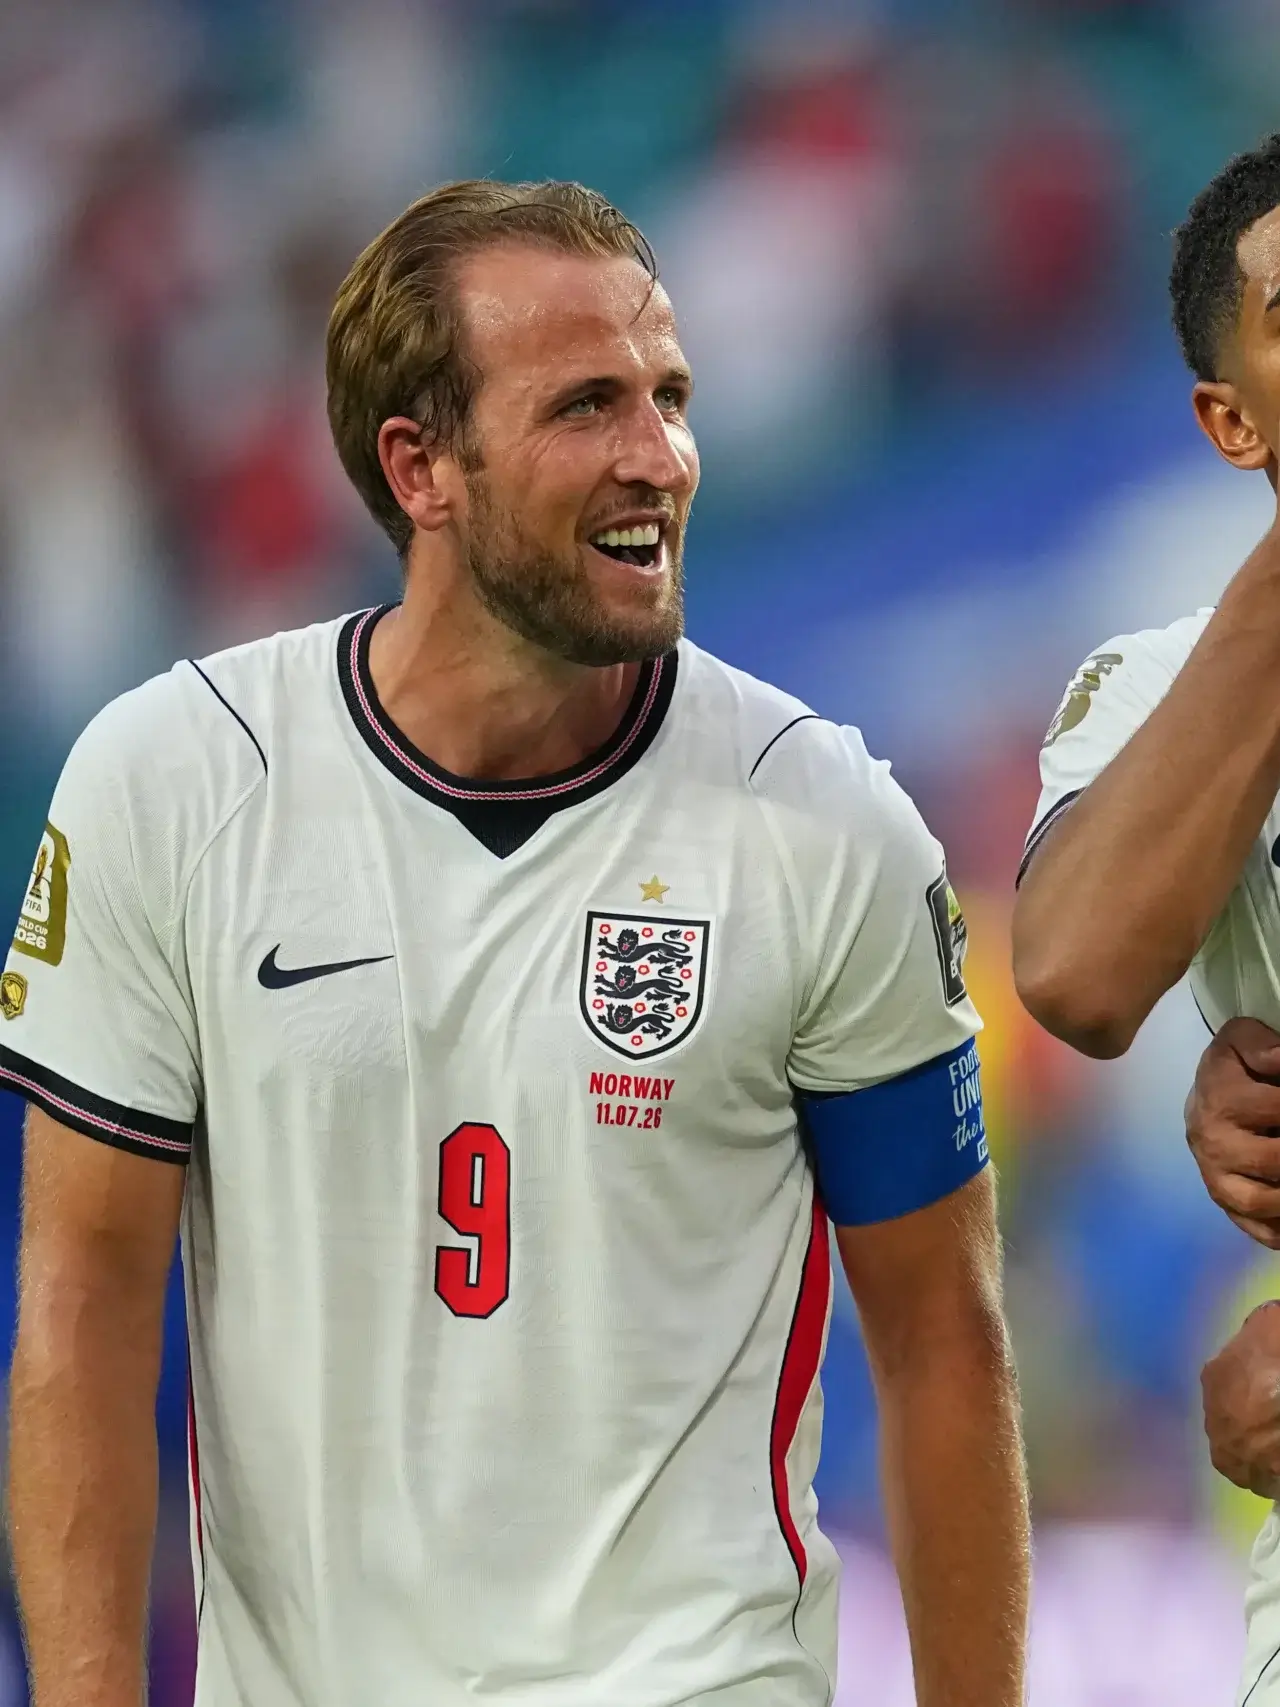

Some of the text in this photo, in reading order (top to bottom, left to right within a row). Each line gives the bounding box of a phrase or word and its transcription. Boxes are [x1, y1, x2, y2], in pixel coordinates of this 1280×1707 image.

[25, 899, 42, 914] FIFA
[14, 925, 47, 950] 026
[35, 925, 48, 936] CUP
[589, 1072, 676, 1101] NORWAY
[597, 1102, 662, 1129] 11.07.26
[952, 1118, 978, 1151] the
[434, 1121, 510, 1319] 9
